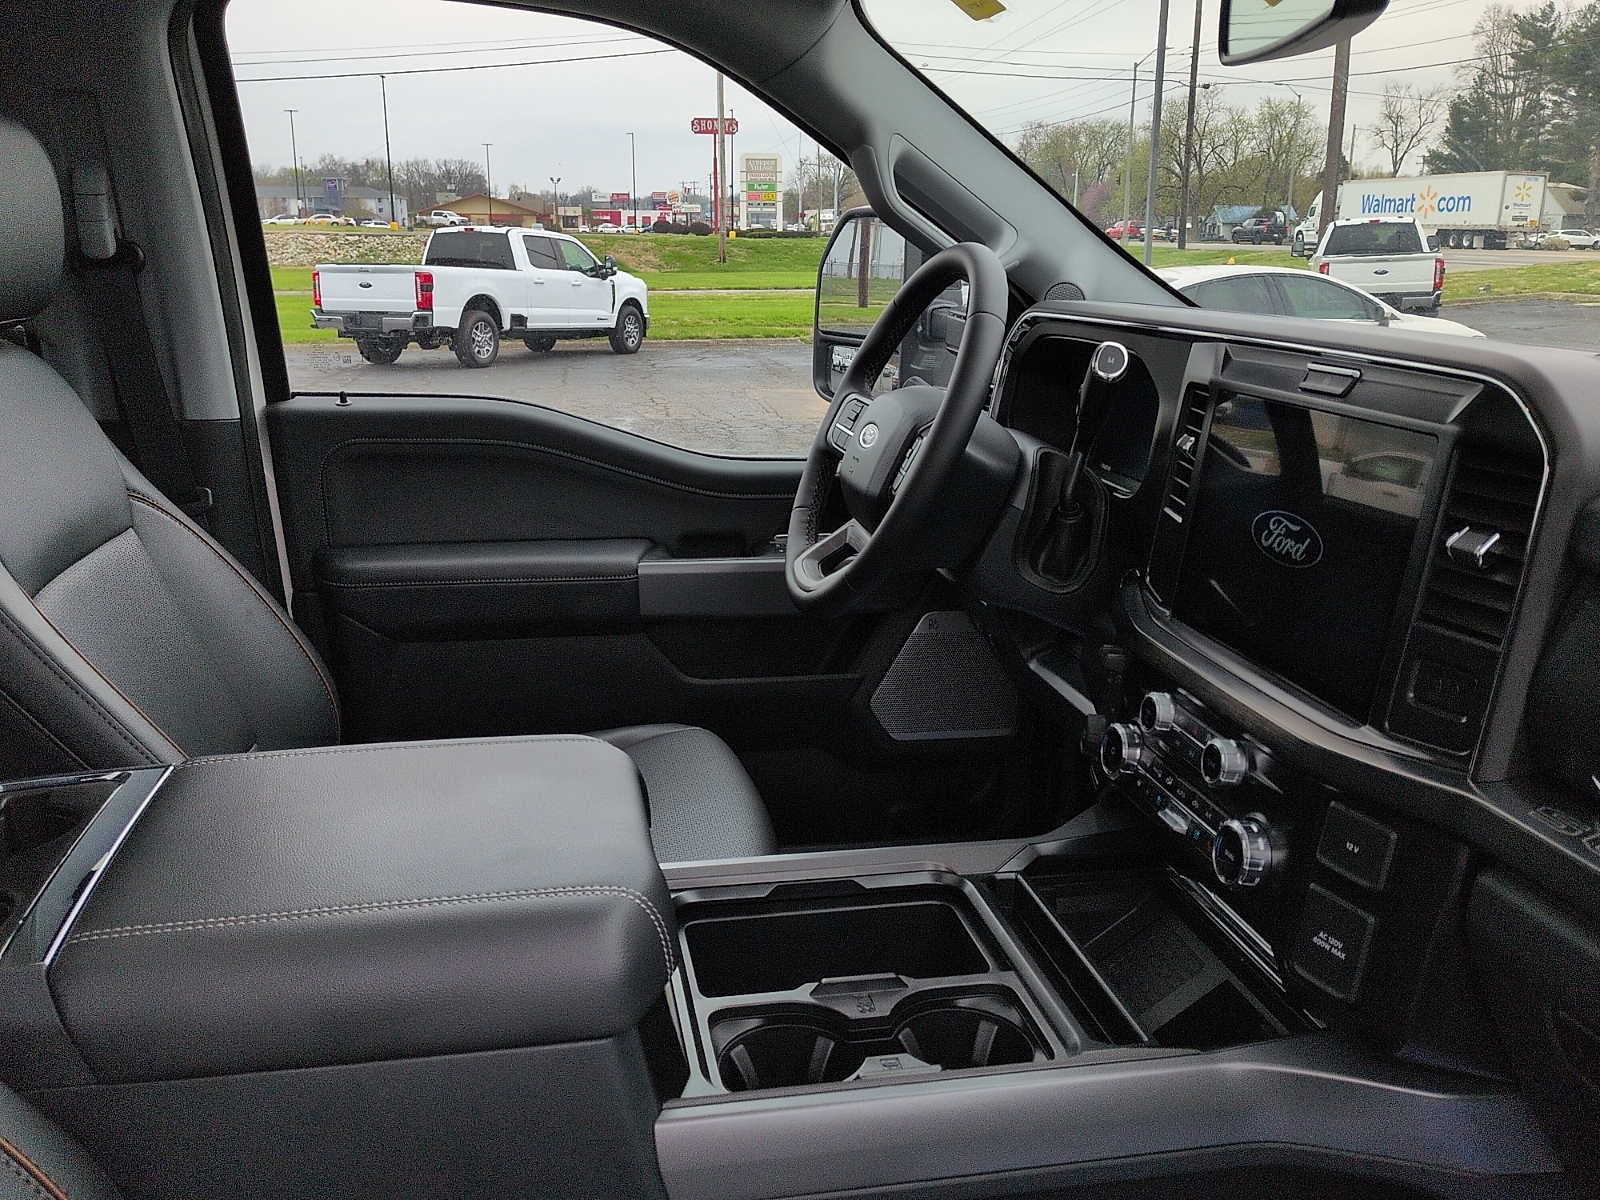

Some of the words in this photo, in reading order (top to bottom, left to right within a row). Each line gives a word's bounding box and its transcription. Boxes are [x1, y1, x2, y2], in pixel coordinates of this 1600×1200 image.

[1361, 193, 1416, 214] Walmart
[1437, 194, 1471, 212] com
[1260, 516, 1311, 561] Ford
